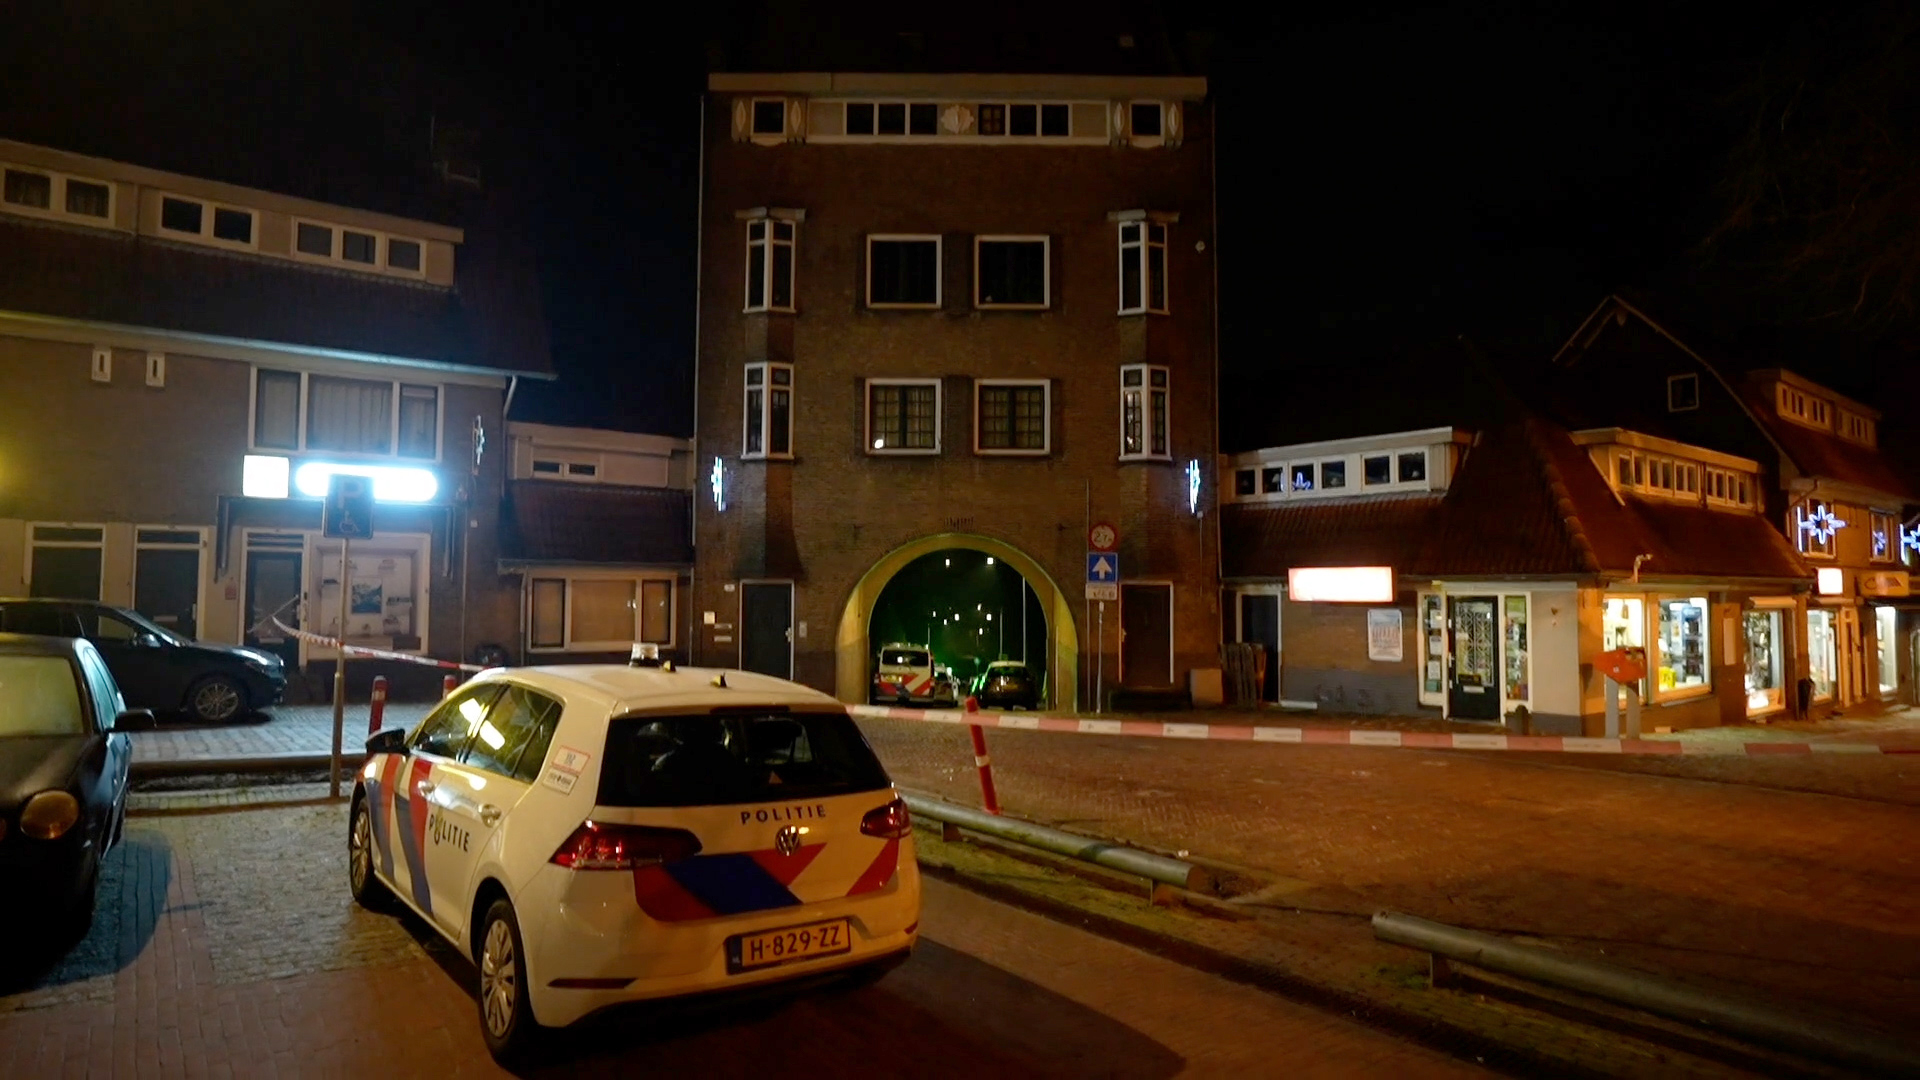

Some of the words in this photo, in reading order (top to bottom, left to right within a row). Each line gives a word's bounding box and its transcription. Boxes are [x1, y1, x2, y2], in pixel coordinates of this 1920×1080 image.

[741, 804, 826, 825] POLITIE
[428, 814, 469, 852] POLITIE
[750, 926, 840, 960] H-829-ZZ
